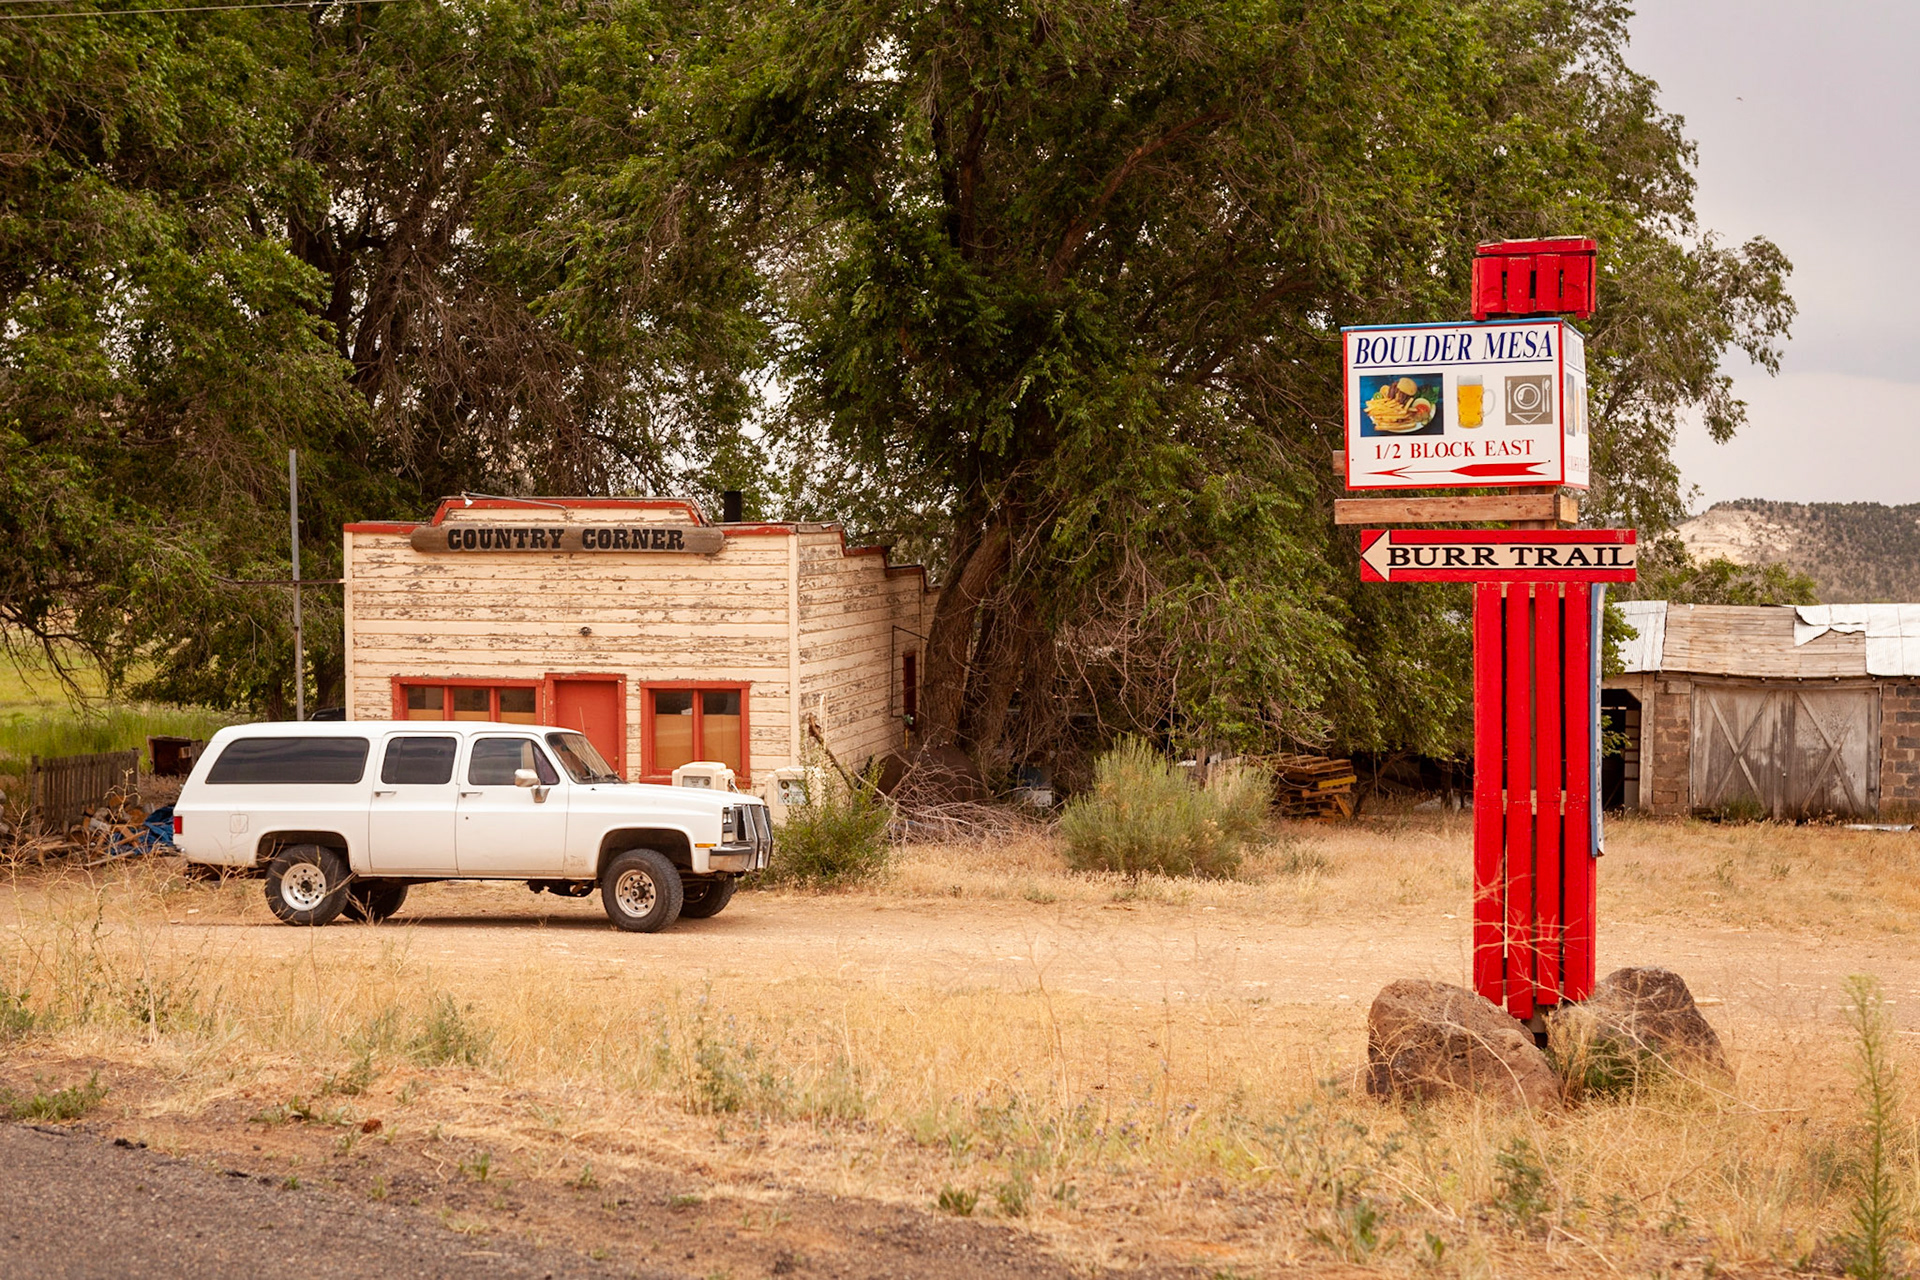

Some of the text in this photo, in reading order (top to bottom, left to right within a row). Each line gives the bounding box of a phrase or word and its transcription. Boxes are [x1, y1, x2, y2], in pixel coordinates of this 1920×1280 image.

[1355, 333, 1473, 364] BOULDER
[1482, 330, 1552, 360] MESA
[1375, 439, 1535, 460] 1/2 BLOCK EAST
[447, 528, 685, 551] COUNTRY CORNER
[1386, 546, 1635, 567] BURR TRAIL
